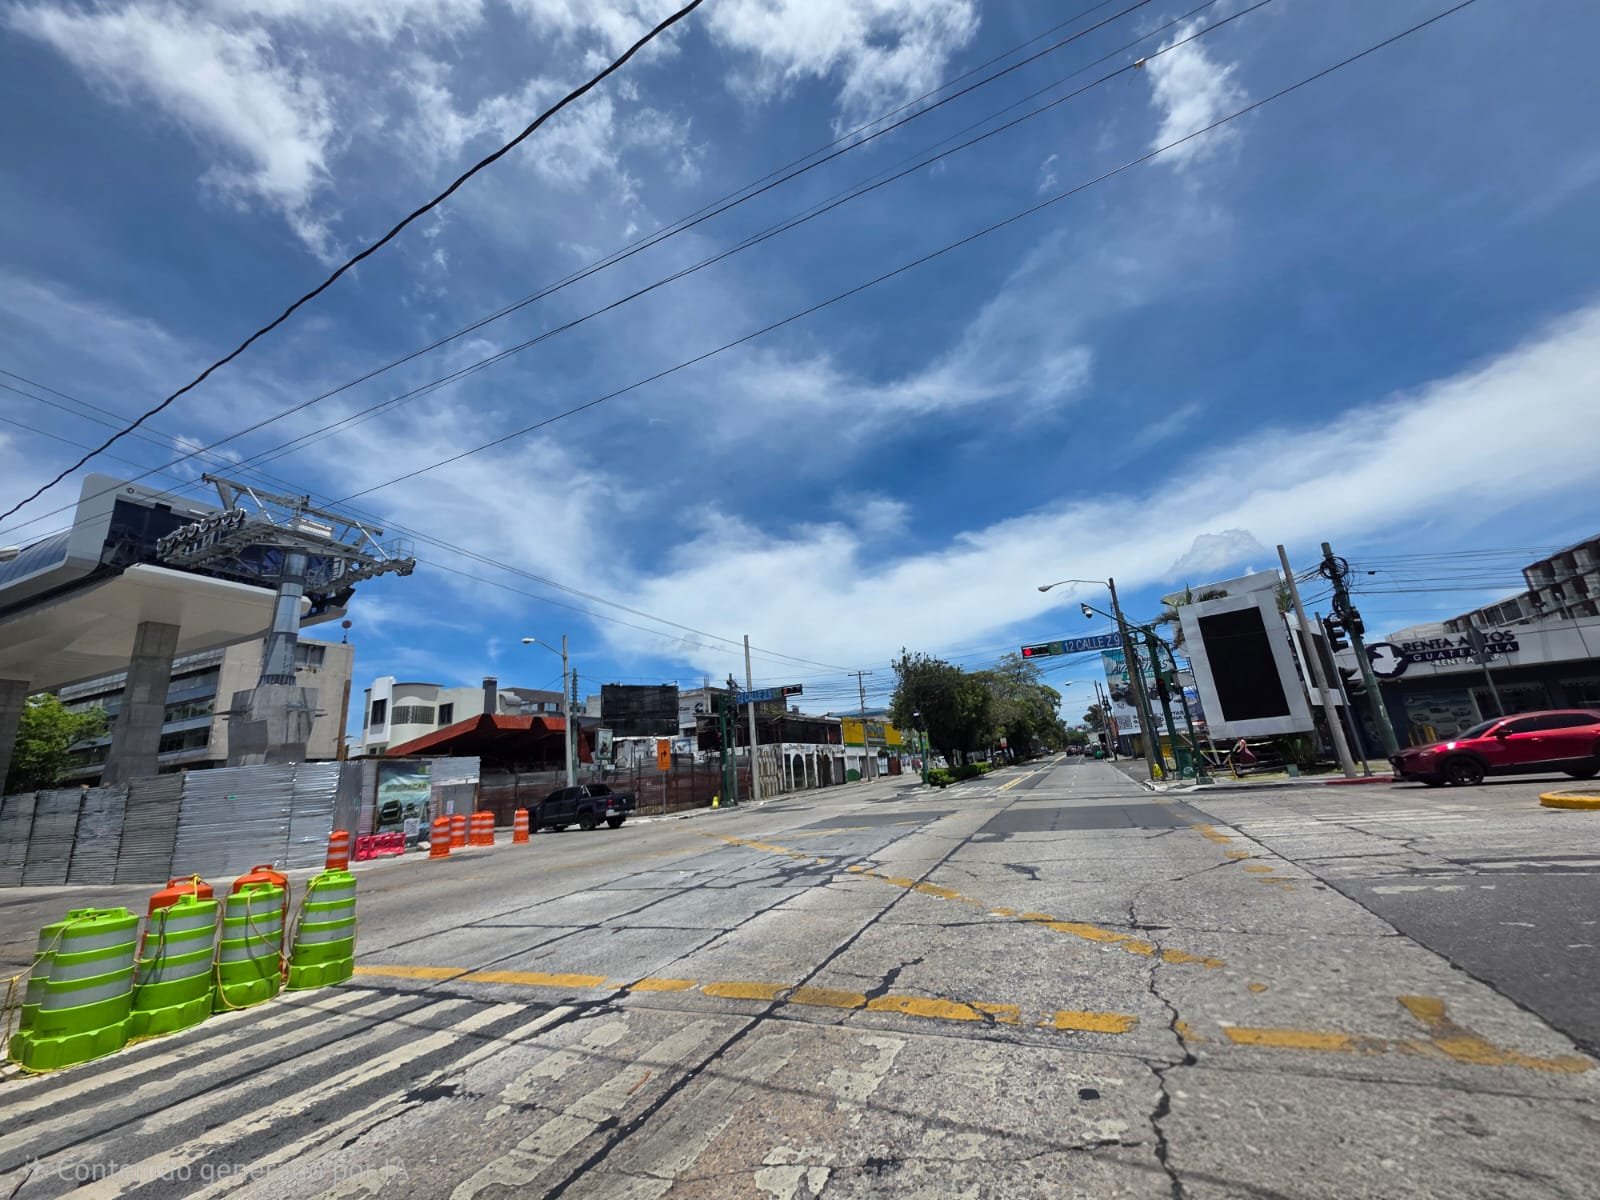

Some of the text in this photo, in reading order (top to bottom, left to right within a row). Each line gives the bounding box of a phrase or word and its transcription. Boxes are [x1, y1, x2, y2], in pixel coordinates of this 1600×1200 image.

[1064, 640, 1074, 652] 12
[1076, 636, 1105, 650] CALLE
[1402, 630, 1516, 653] RENTA ATOS
